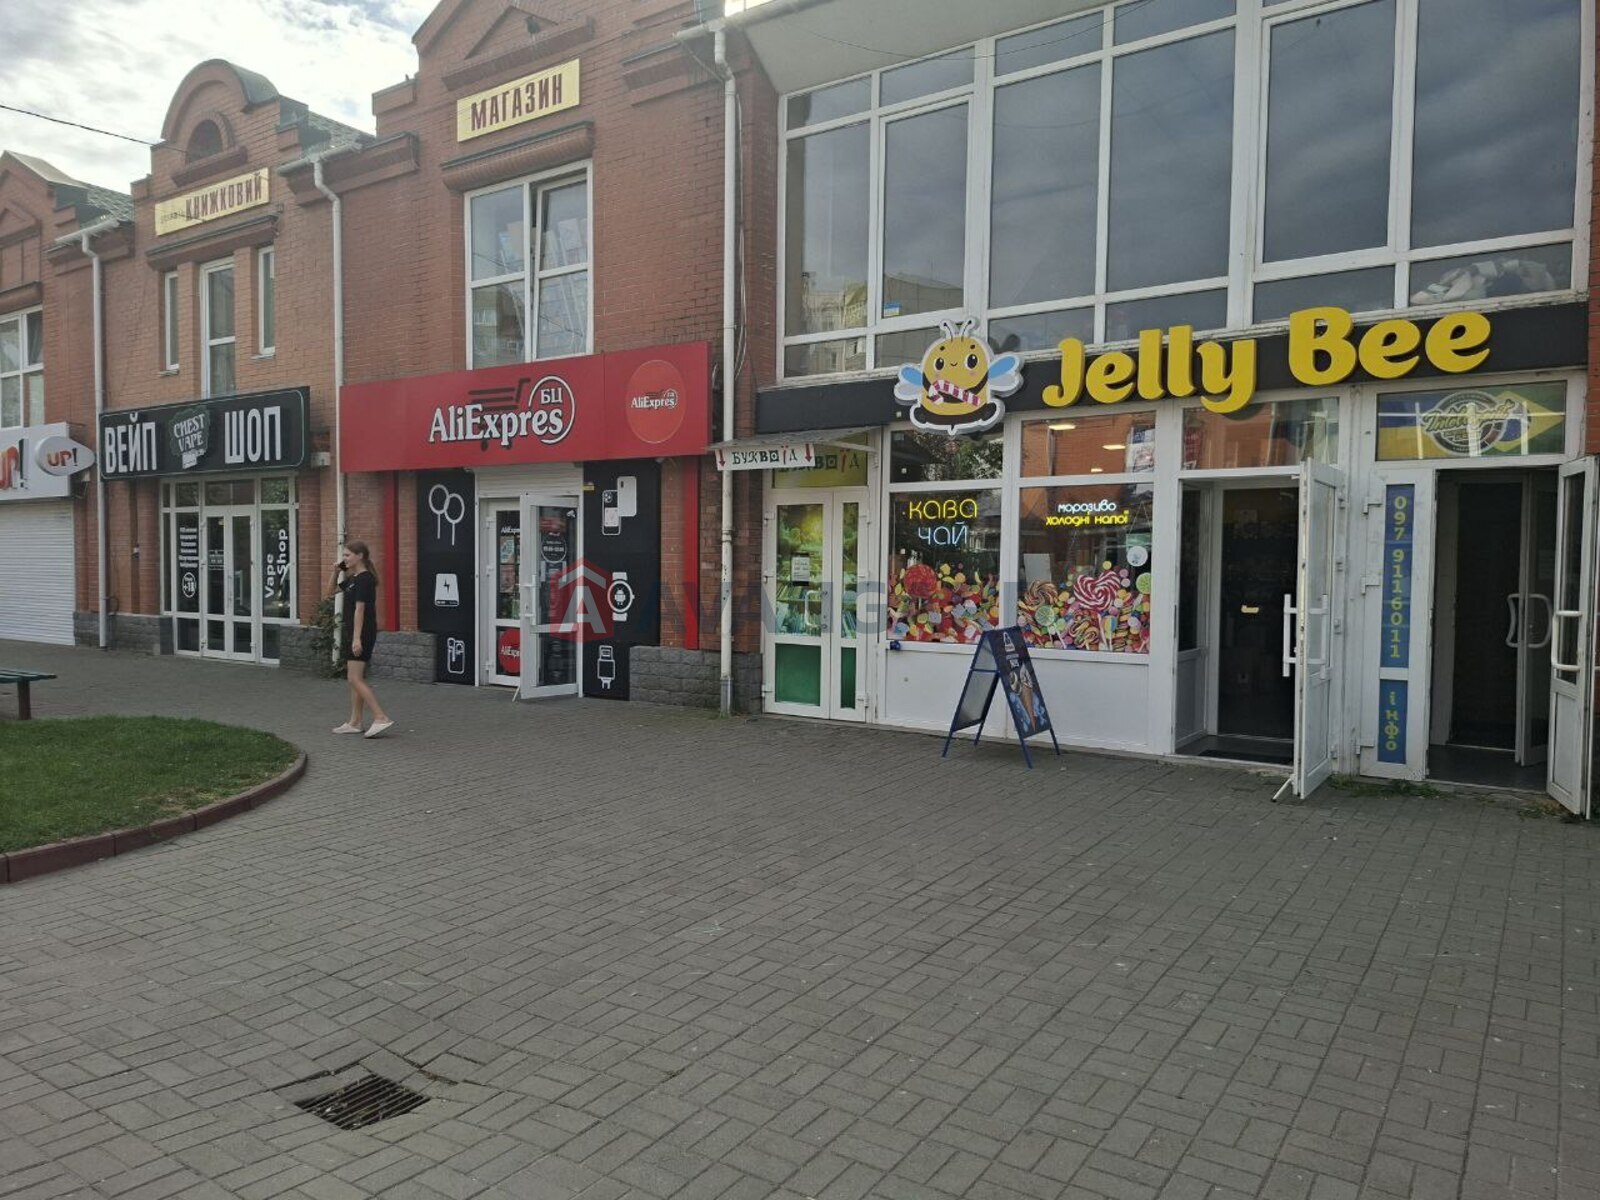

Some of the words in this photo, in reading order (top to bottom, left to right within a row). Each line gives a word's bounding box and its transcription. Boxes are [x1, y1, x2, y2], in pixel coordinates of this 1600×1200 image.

[470, 73, 563, 131] МАГАЗИН
[185, 172, 262, 221] КНИЖКОВИЙ
[1042, 325, 1256, 414] Jelly
[1288, 306, 1491, 386] Bee
[540, 387, 564, 405] БЦ
[104, 412, 158, 474] ВЕЙП
[174, 413, 205, 438] CHEST
[178, 432, 204, 452] VAPE
[224, 405, 282, 464] ШОП
[428, 403, 564, 446] AliExpres
[47, 447, 79, 467] UP!
[1393, 495, 1408, 541] 097
[264, 553, 276, 598] Vape
[277, 529, 289, 576] Shop
